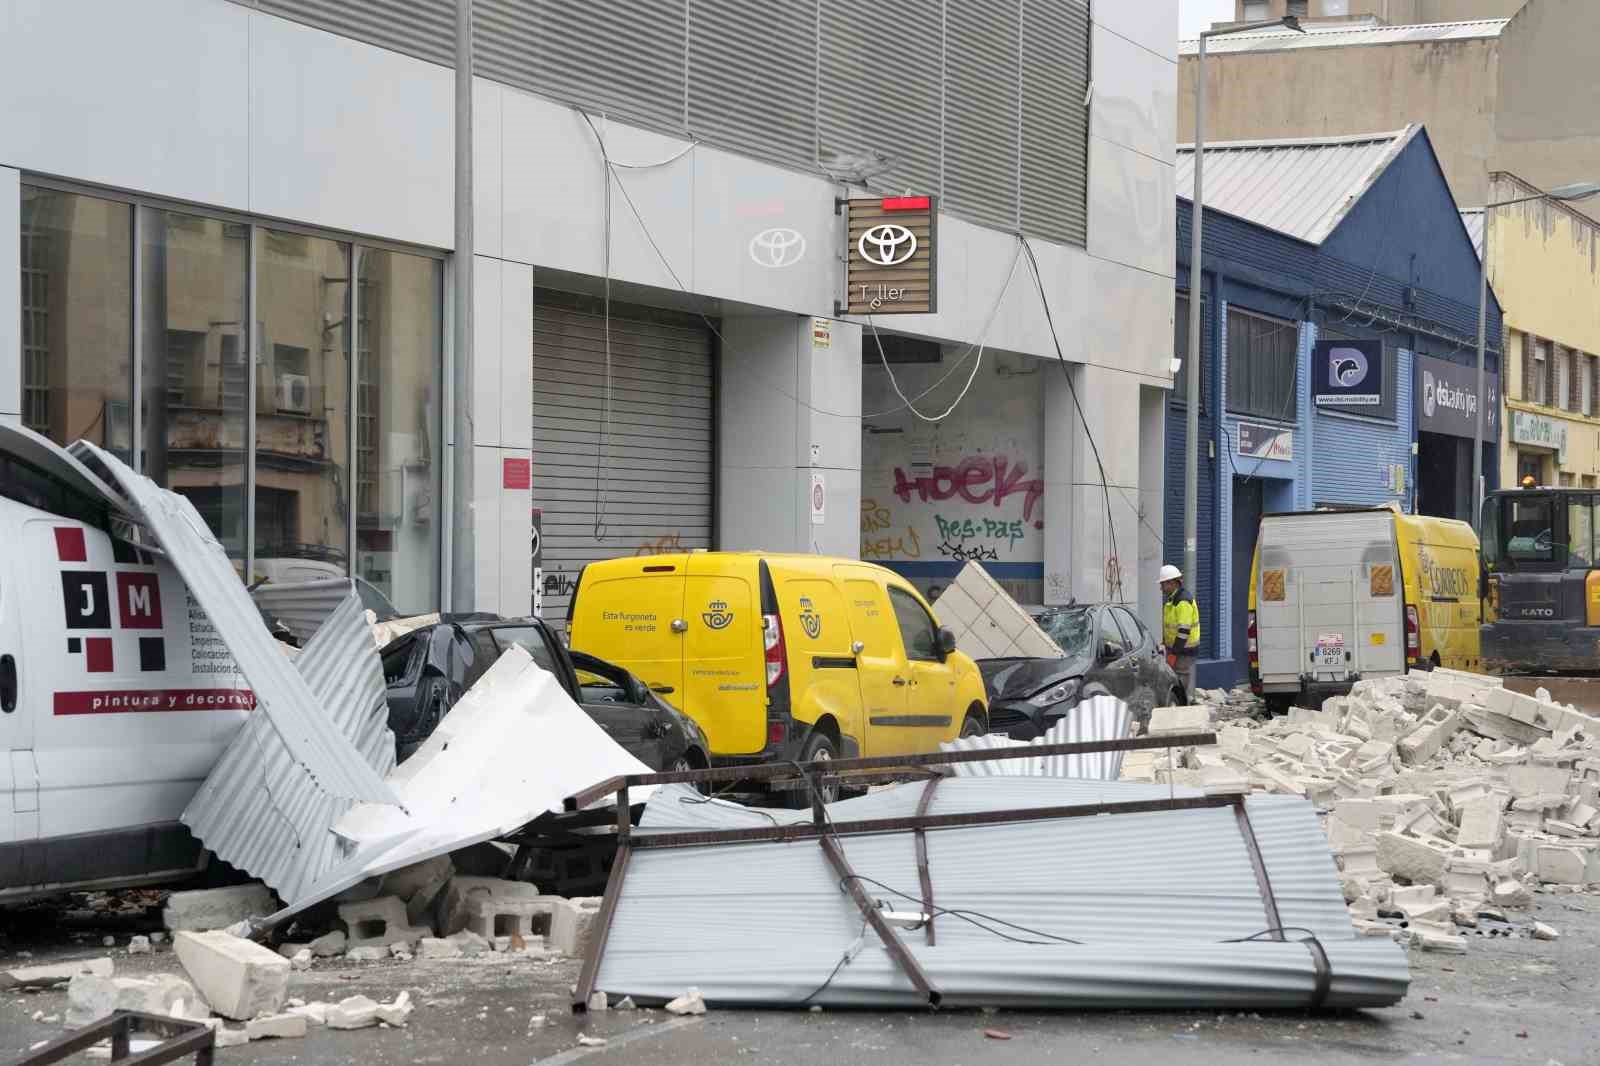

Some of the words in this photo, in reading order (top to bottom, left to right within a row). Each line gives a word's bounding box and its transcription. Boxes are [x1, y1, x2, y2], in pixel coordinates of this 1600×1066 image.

[80, 584, 95, 616] J
[128, 585, 151, 616] M
[1521, 608, 1553, 616] KATO
[93, 695, 159, 710] pintura
[169, 696, 177, 707] y
